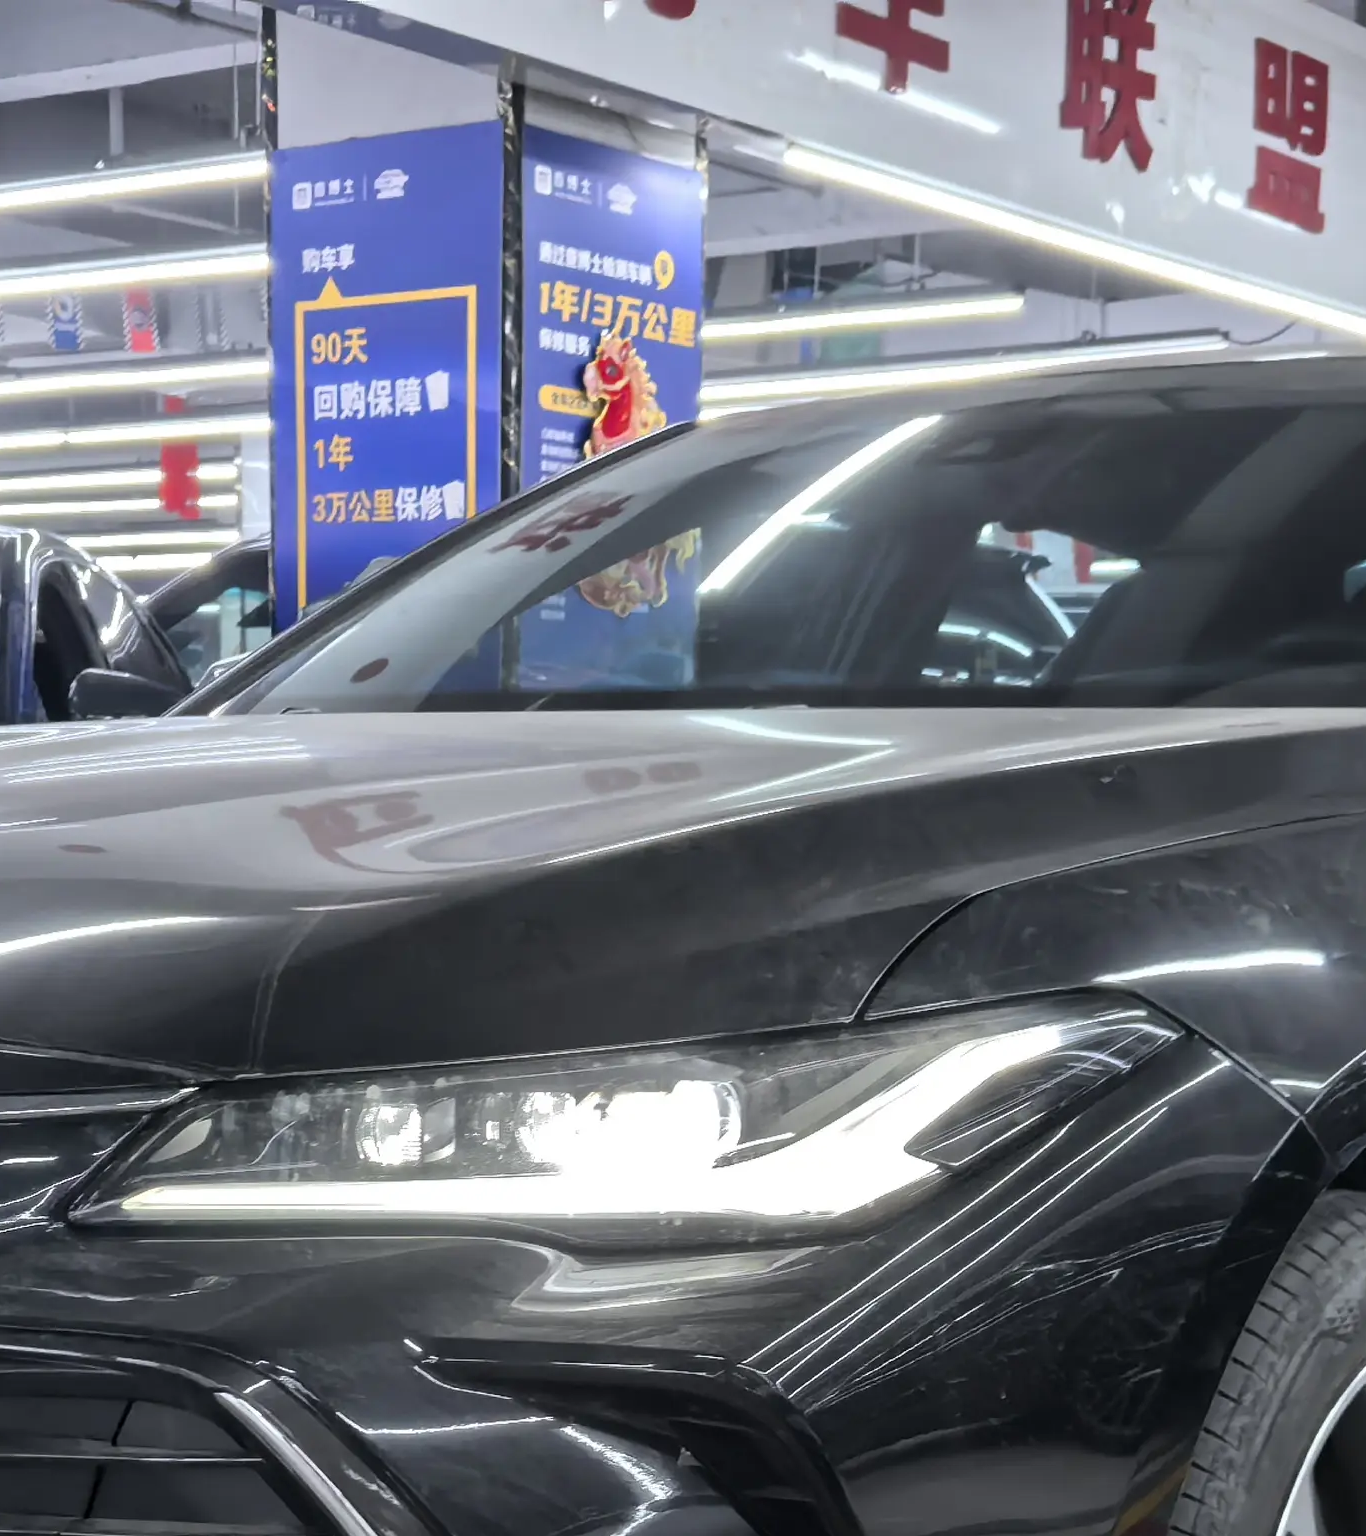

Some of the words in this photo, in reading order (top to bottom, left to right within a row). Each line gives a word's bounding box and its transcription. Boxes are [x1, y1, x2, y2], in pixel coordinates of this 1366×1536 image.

[311, 327, 368, 365] 90天
[313, 376, 422, 421] 回购保障
[314, 434, 354, 472] 1年
[312, 485, 443, 524] 3万公里保修
